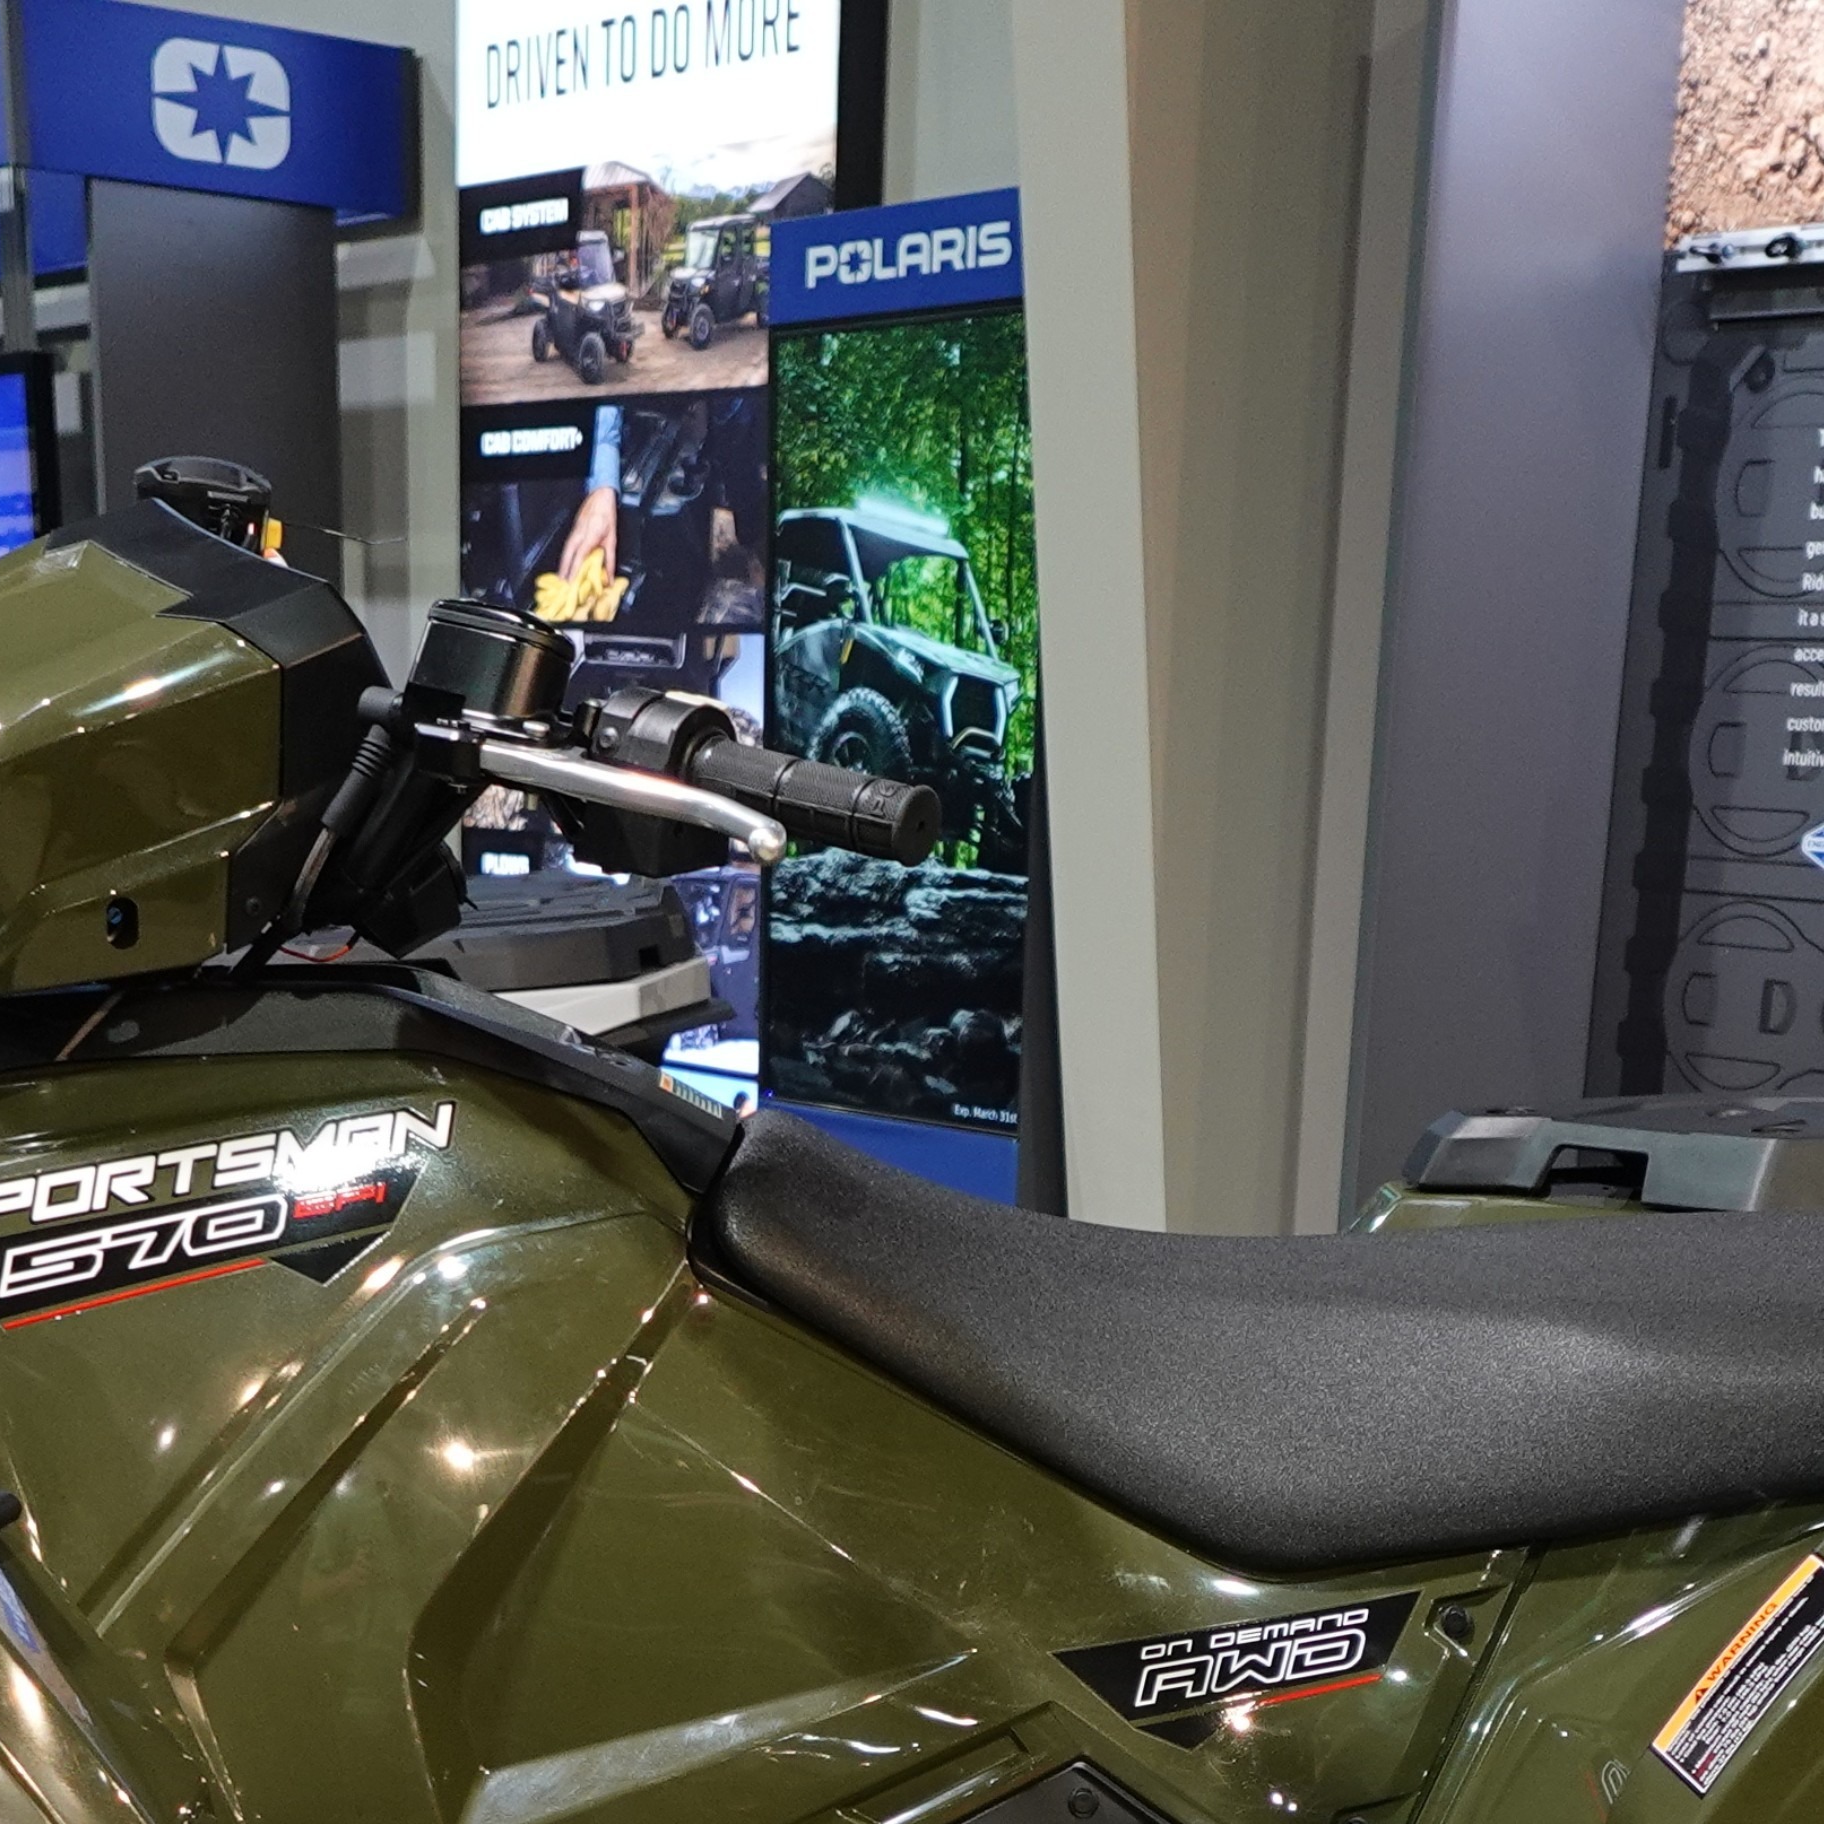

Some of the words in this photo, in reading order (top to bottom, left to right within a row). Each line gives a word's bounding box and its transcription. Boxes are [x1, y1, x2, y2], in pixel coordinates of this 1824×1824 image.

[487, 28, 588, 109] DRIVEN
[601, 18, 635, 84] TO
[651, 5, 693, 78] DO
[704, 0, 800, 68] MORE
[511, 197, 569, 230] SYSTEM
[805, 221, 1013, 289] POLARIS
[1798, 609, 1808, 626] it
[1809, 612, 1819, 626] a
[973, 1106, 999, 1121] March
[1140, 1639, 1194, 1661] ON
[1210, 1608, 1370, 1650] DEMAND
[1707, 1602, 1779, 1683] WARNING
[1134, 1628, 1366, 1708] AWD
